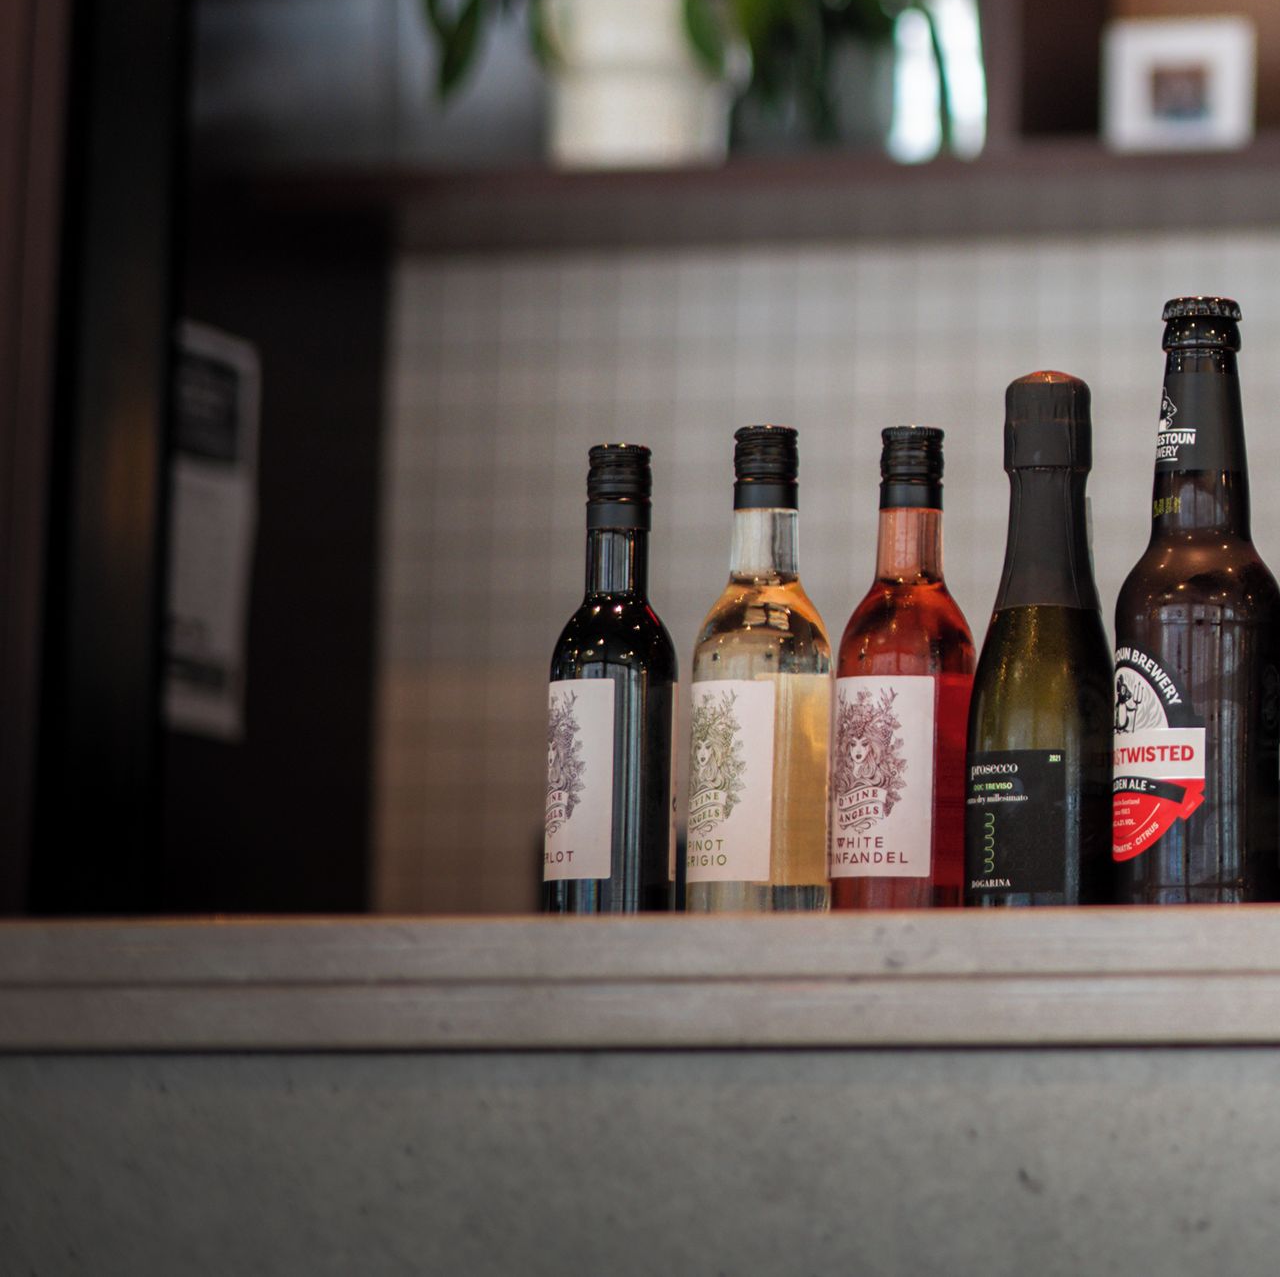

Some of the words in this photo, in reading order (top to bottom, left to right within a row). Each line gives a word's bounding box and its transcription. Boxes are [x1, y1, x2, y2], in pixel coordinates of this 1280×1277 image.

[1131, 649, 1182, 705] BREWERY
[971, 763, 1018, 781] prosecco
[985, 782, 1013, 790] TREVISO
[1129, 779, 1147, 791] ALE
[839, 806, 879, 823] ANGELS
[1135, 821, 1160, 846] CITRUS
[837, 837, 883, 848] WHITE
